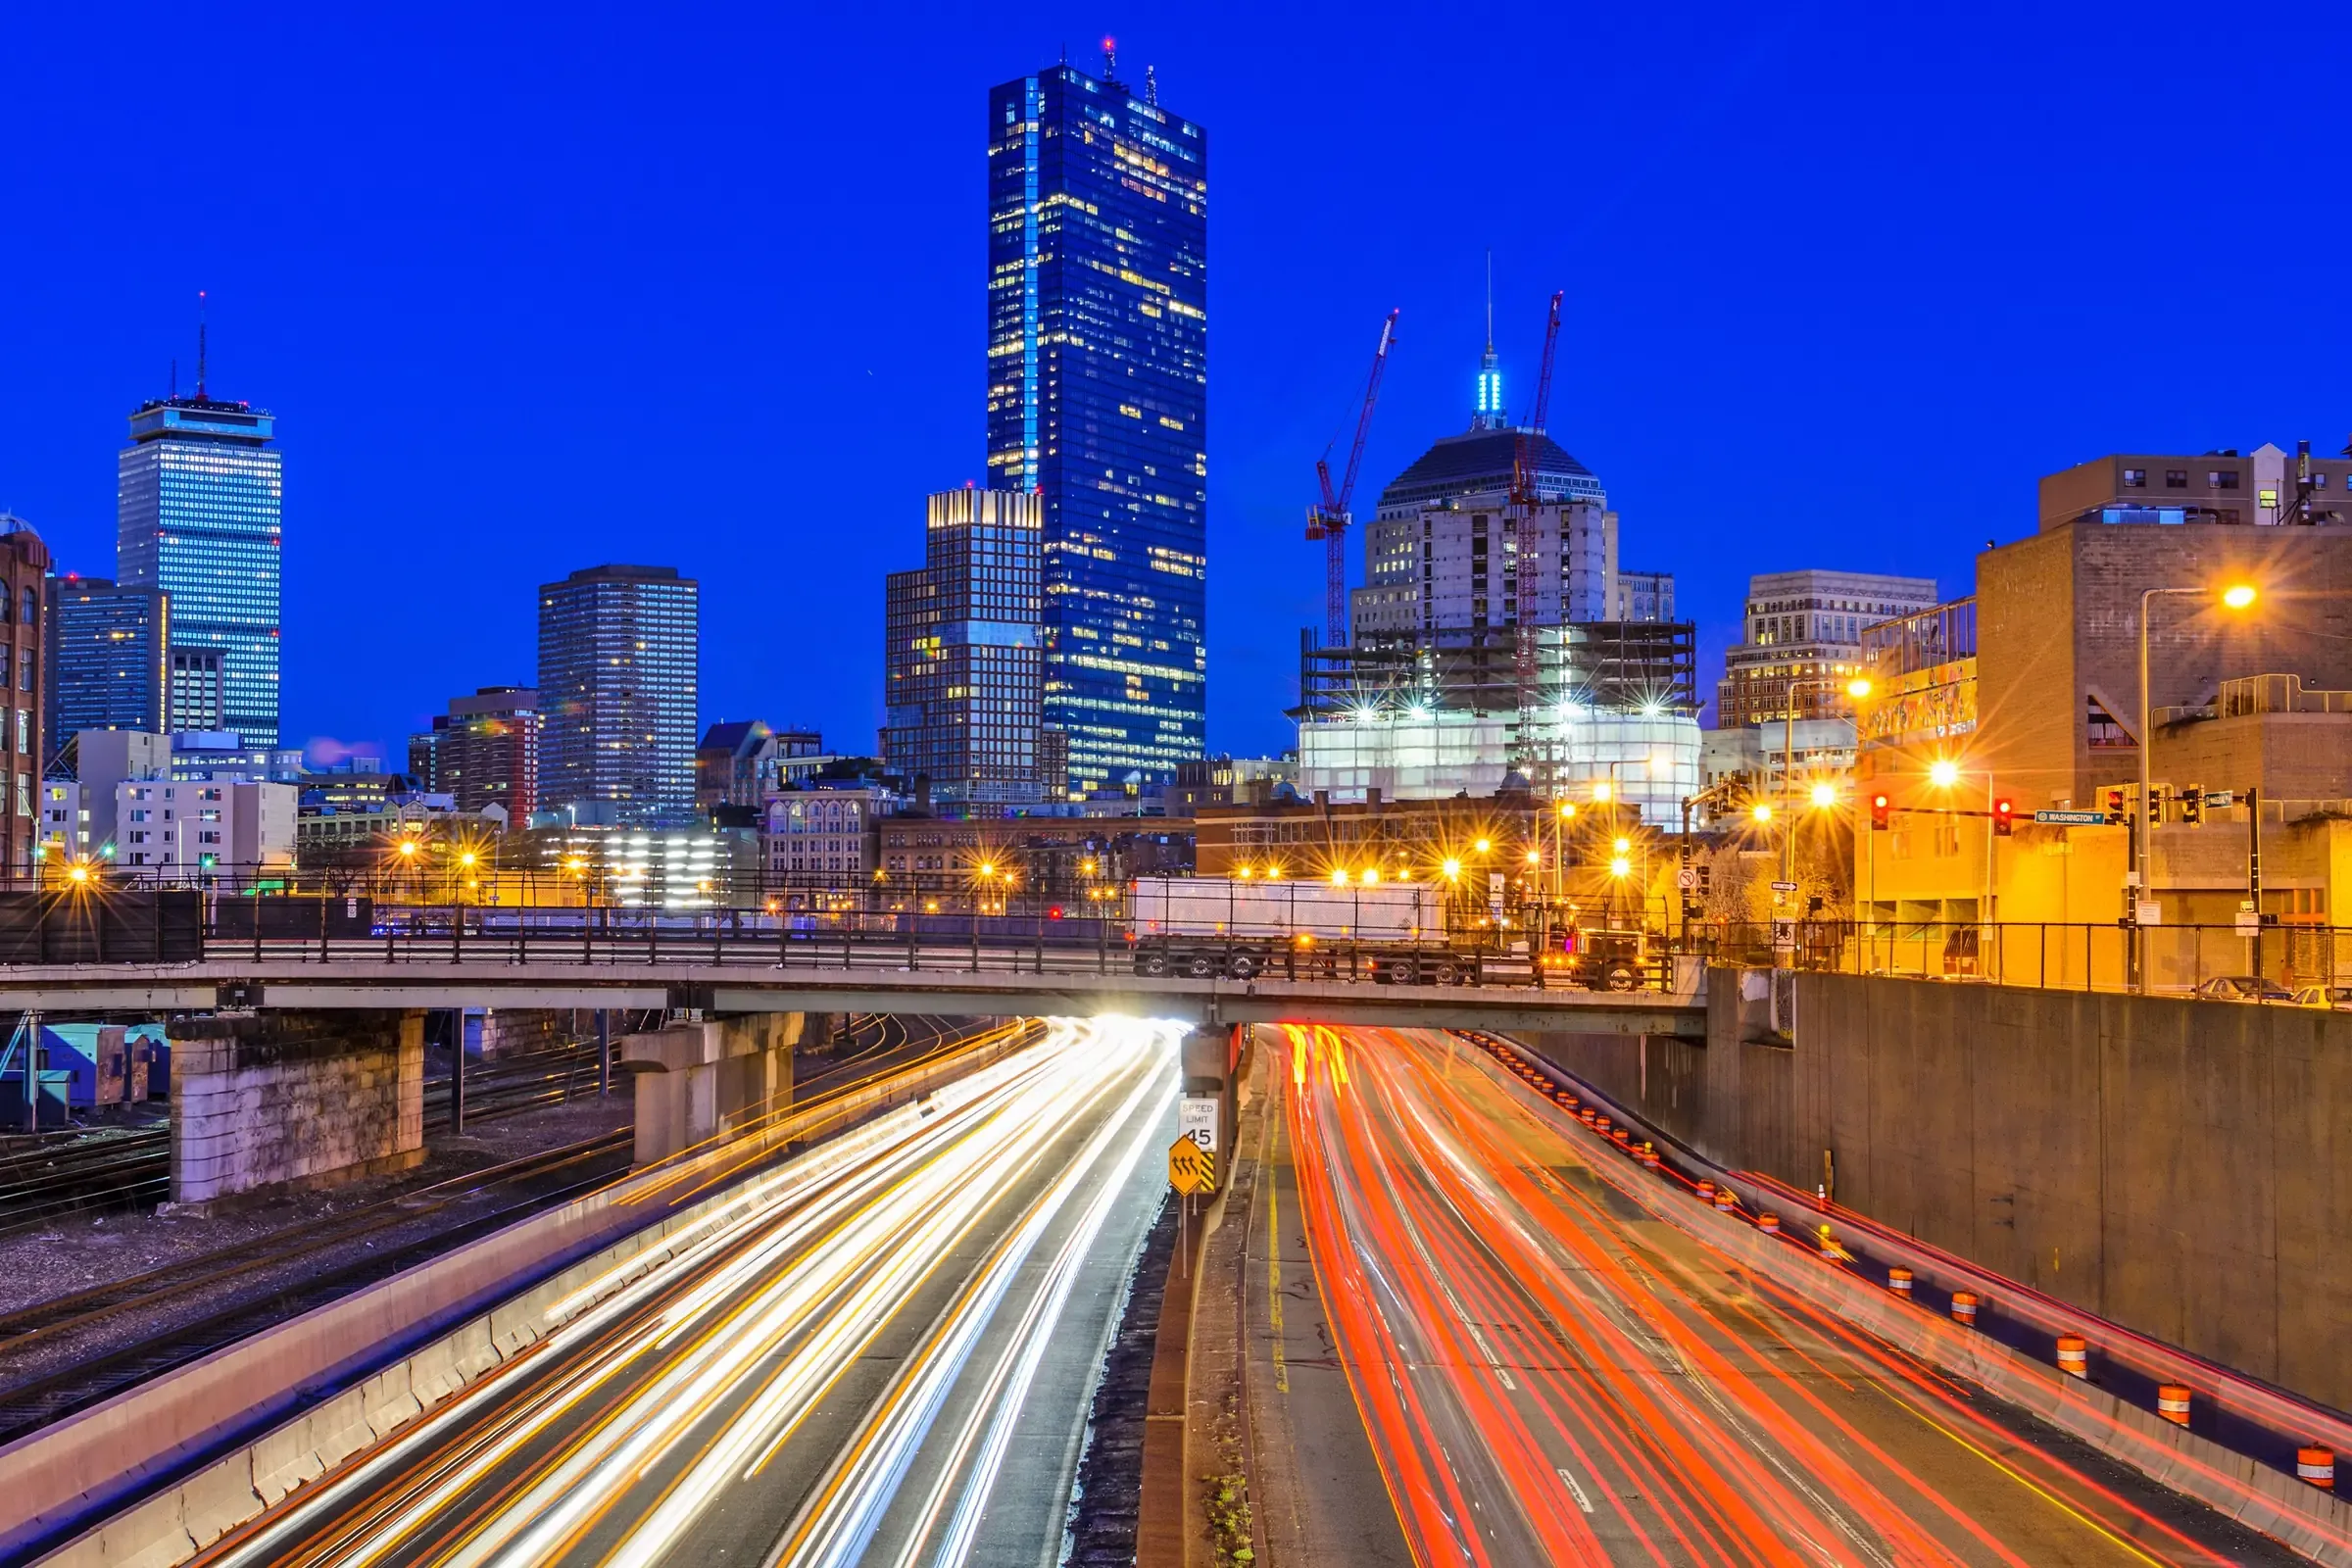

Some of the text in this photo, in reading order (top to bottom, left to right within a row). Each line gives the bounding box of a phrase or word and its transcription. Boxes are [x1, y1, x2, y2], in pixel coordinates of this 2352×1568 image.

[2048, 813, 2093, 822] WASHINGTON
[1182, 1104, 1214, 1113] SPEED
[1187, 1128, 1211, 1145] 45
